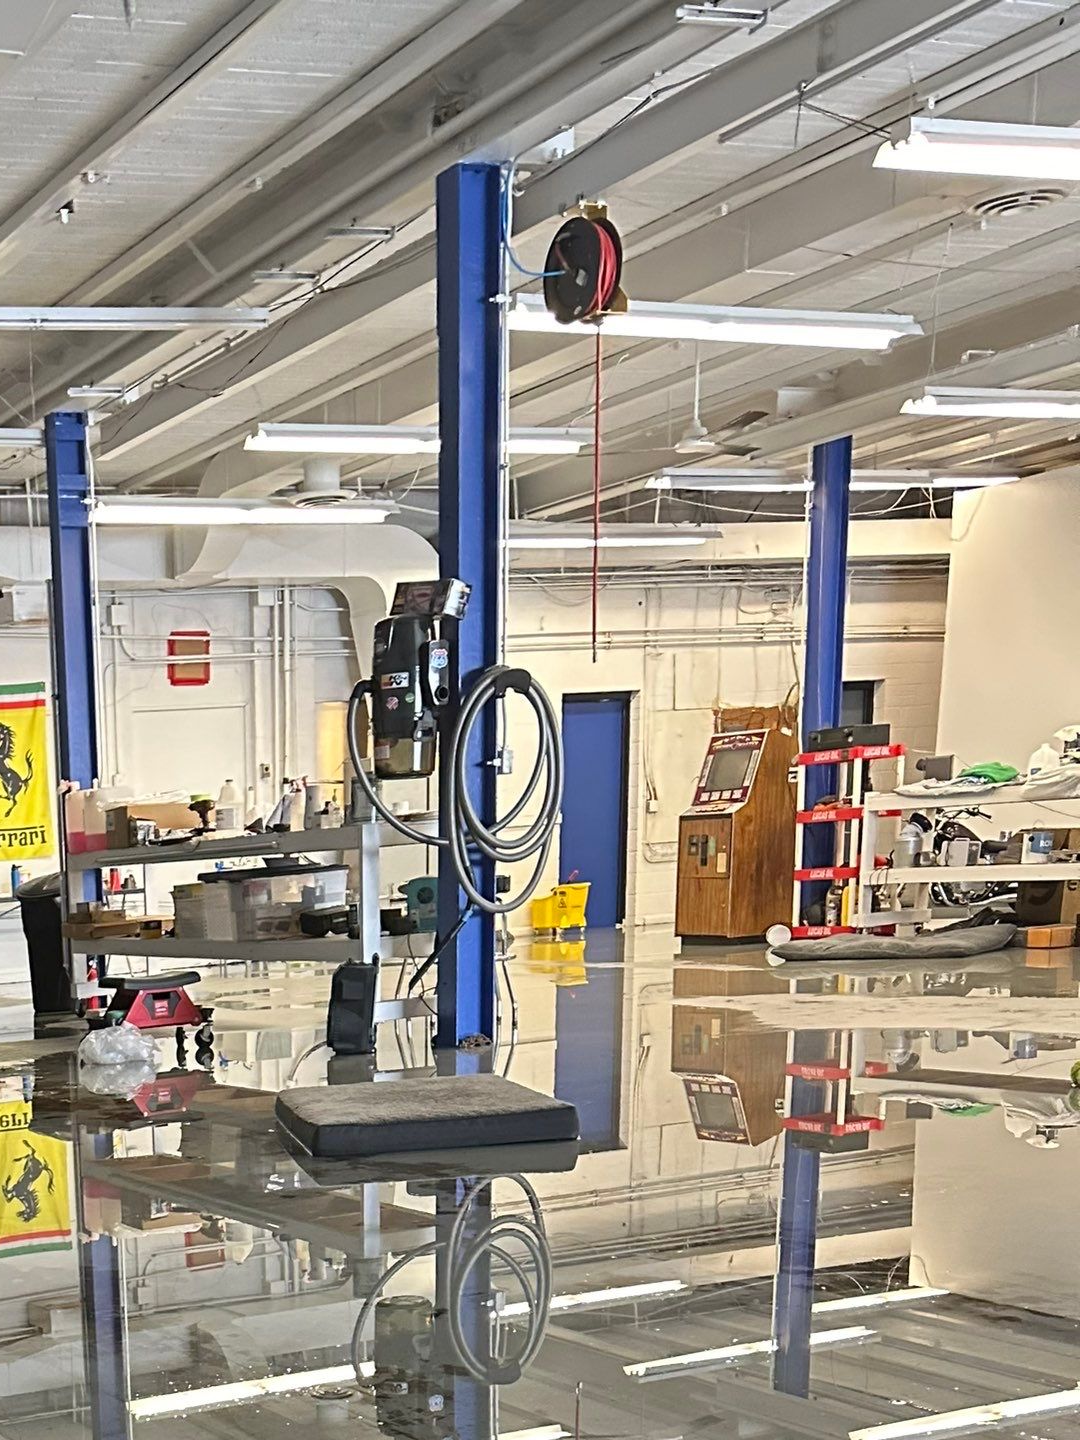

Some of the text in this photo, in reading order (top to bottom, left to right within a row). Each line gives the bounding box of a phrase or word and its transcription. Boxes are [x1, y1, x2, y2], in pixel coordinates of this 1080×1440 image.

[814, 751, 830, 762] LUCAS
[809, 869, 825, 878] LUCAS
[807, 927, 823, 936] LUCAS
